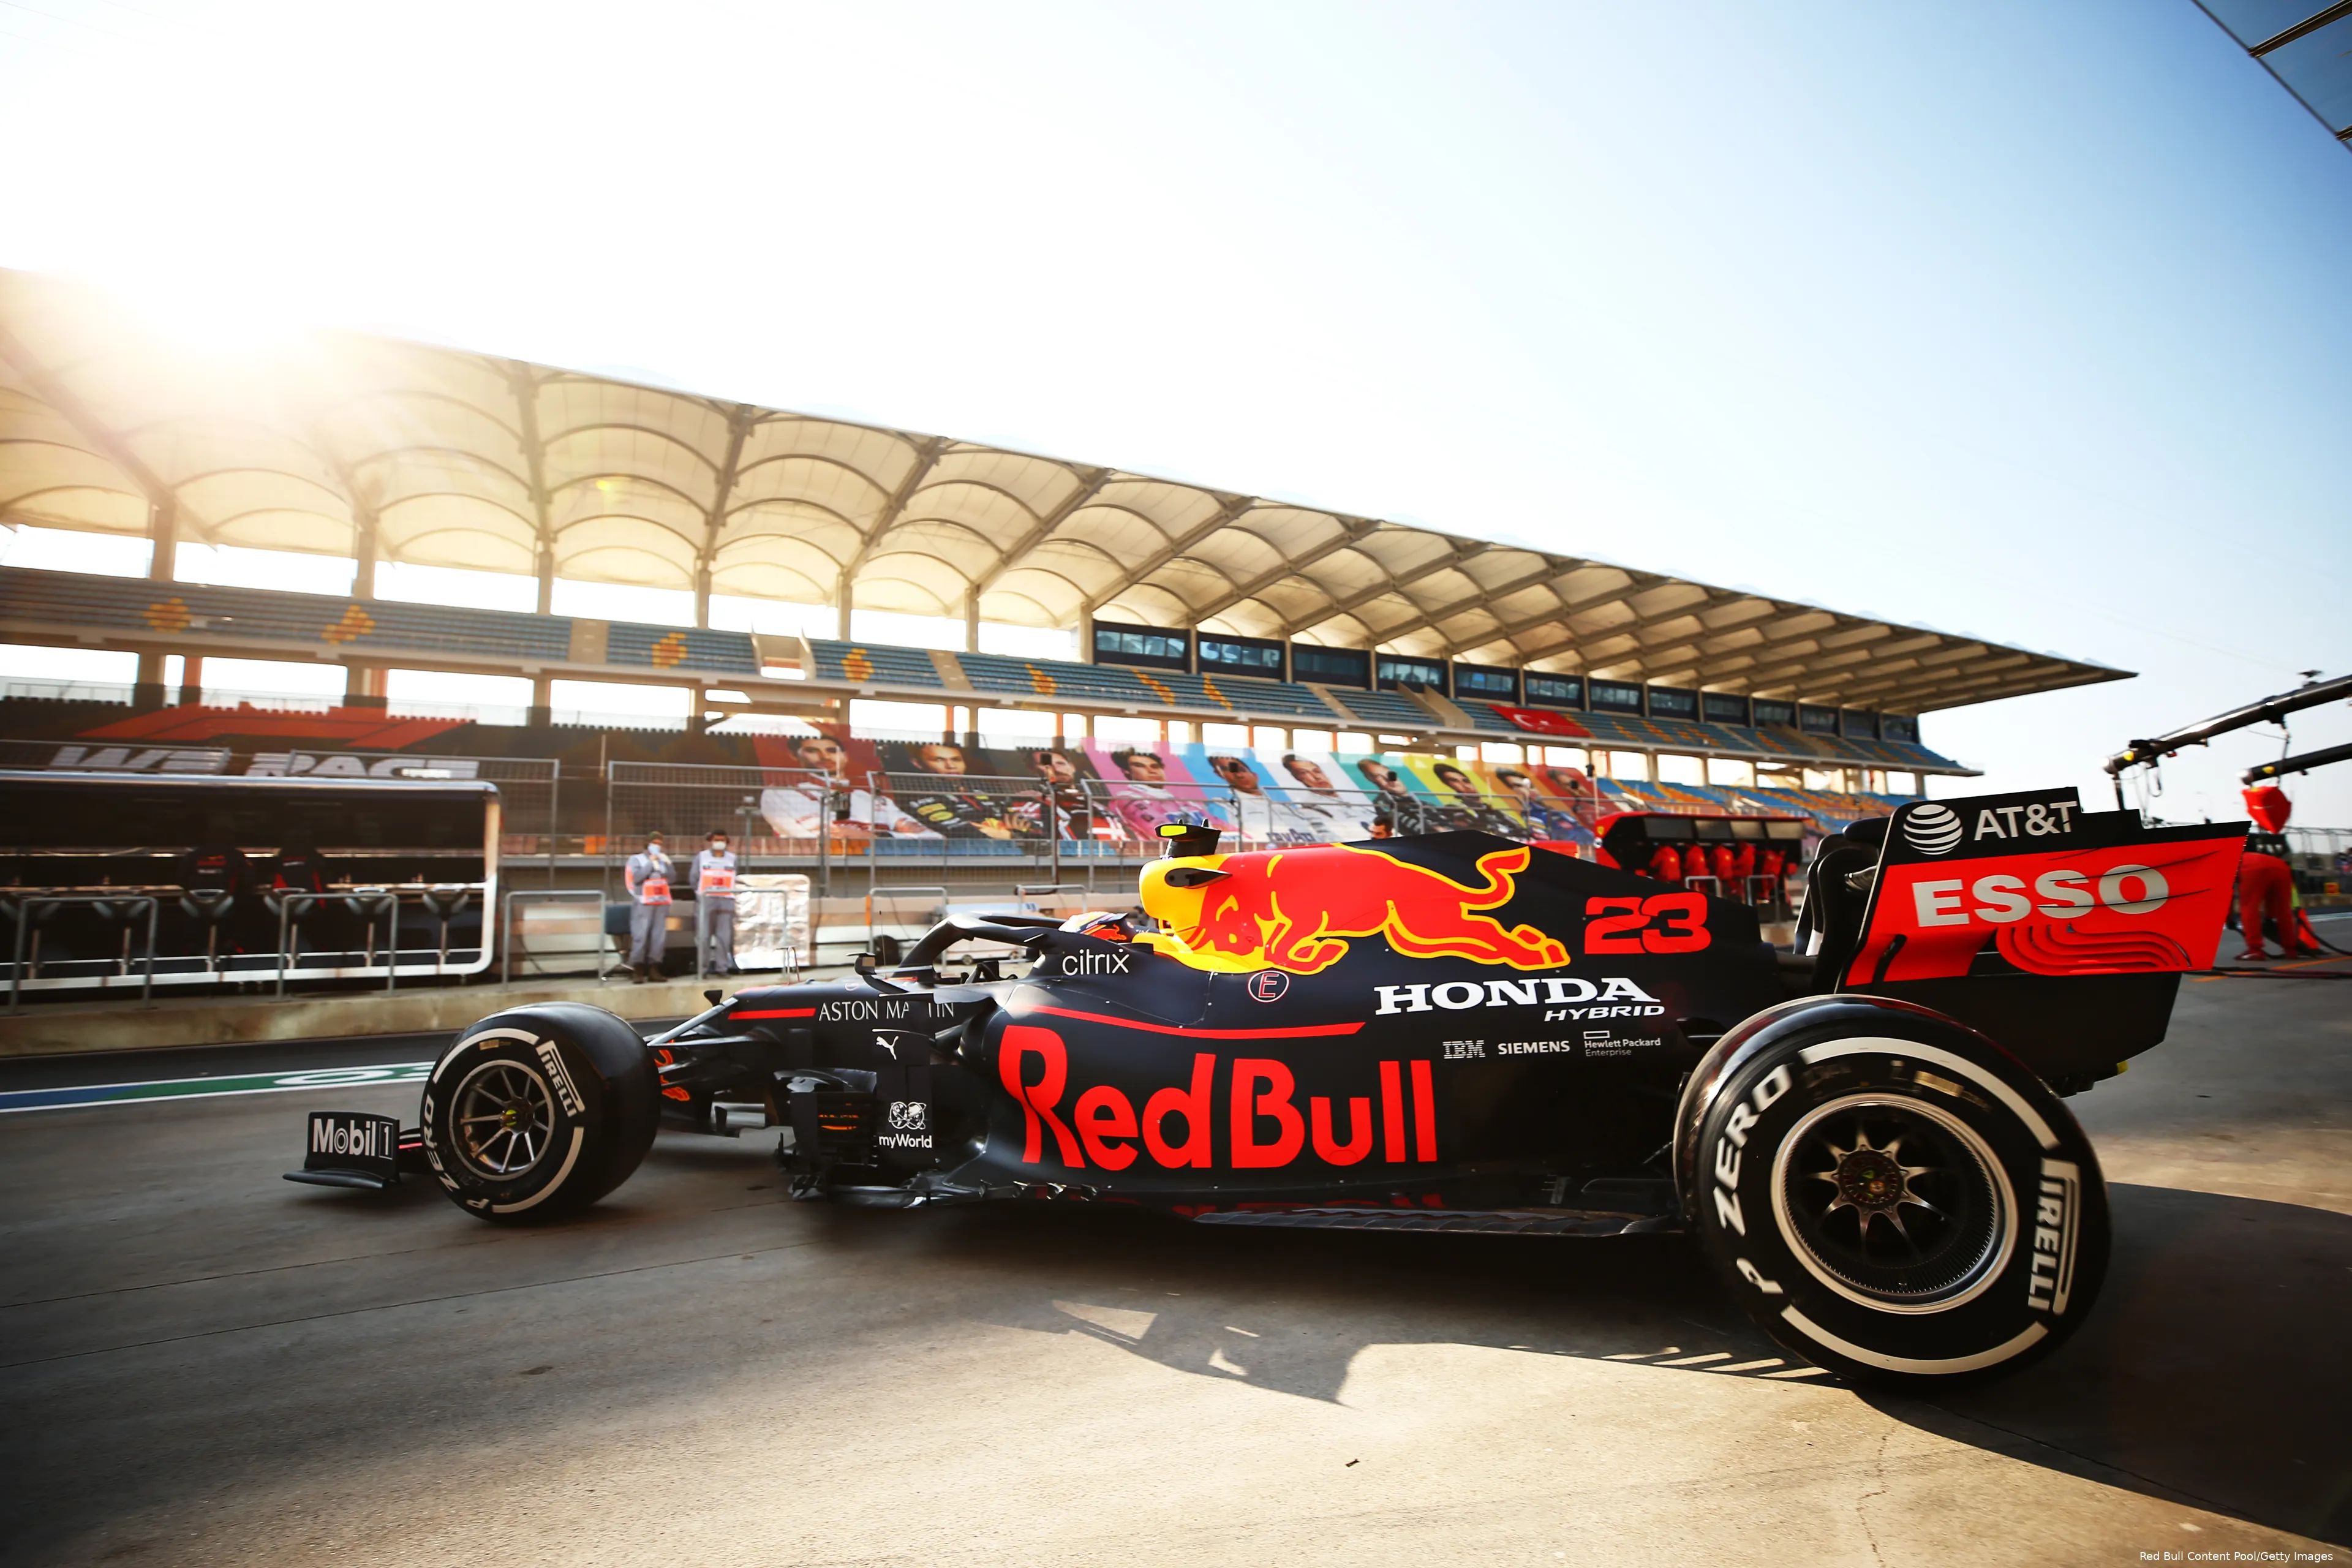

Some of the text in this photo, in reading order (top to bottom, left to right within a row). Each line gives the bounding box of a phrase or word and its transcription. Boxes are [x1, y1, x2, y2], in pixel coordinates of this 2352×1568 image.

[1973, 801, 2078, 842] AT&T
[1912, 864, 2169, 927] ESSO
[1584, 892, 1712, 954] 23
[1062, 948, 1130, 976] citrix
[818, 1000, 954, 1022] ASTON MATIN
[1373, 977, 1661, 1015] HONDA
[1544, 1005, 1665, 1022] HYBRID
[1442, 1039, 1486, 1059] IBM
[1498, 1040, 1570, 1055] SIEMENS
[1584, 1038, 1661, 1049] Hewlett Packard
[1585, 1048, 1632, 1057] Enterprise
[536, 1040, 586, 1118] PIRELLI
[998, 1025, 1438, 1170] Red Bull
[312, 1118, 377, 1156] Mobil
[423, 1093, 461, 1193] ZERO
[878, 1133, 933, 1148] myWorld
[1713, 1063, 1793, 1237] ZERO
[2027, 1157, 2081, 1316] PIRELLI
